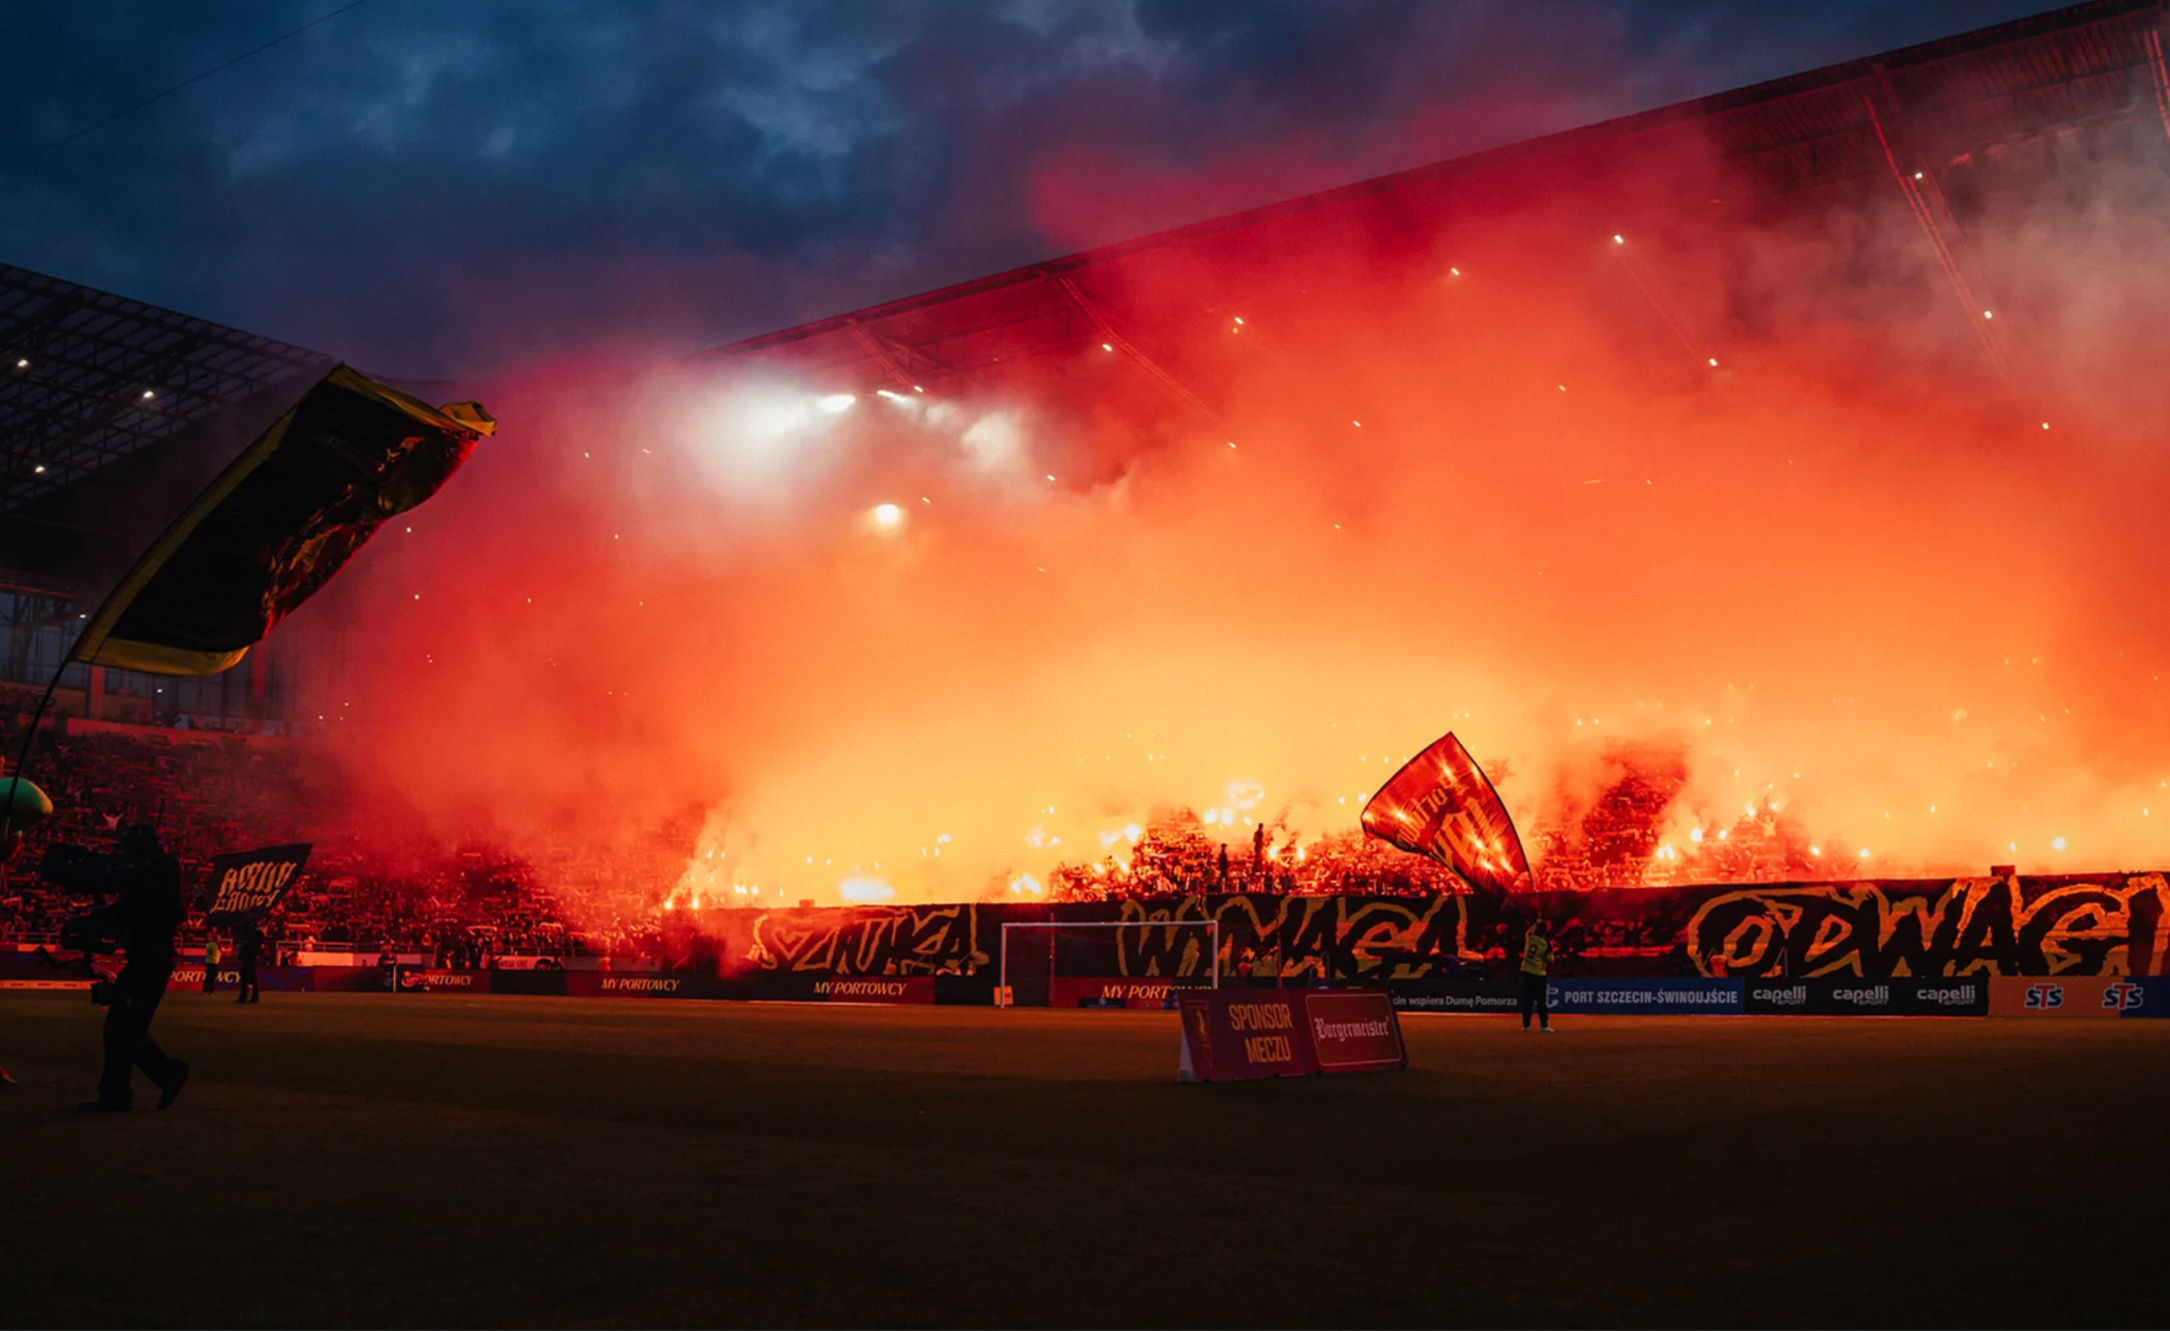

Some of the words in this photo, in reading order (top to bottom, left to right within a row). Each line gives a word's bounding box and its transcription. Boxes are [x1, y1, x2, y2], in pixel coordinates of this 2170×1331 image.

[1687, 872, 2170, 977] ODWAGI
[601, 978, 618, 991] MY
[619, 978, 680, 992] PORTOWCY
[813, 981, 834, 995] MY
[834, 981, 907, 996] PORTOWCY
[1101, 985, 1128, 999] MY
[1752, 985, 1807, 1004] capelli
[1832, 985, 1889, 1004] capelli
[1916, 984, 1976, 1004] capelli
[1409, 995, 1445, 1009] wspiera
[1475, 995, 1518, 1007] Pomorza
[1564, 990, 1596, 1004] PORT
[1597, 987, 1738, 1004] SZCZECIN-ŚWINOUJŚCIE
[2024, 983, 2064, 1010] STS
[2102, 983, 2143, 1010] STS
[1228, 1003, 1293, 1031] SPONSOR
[1245, 1036, 1292, 1064] MECZU
